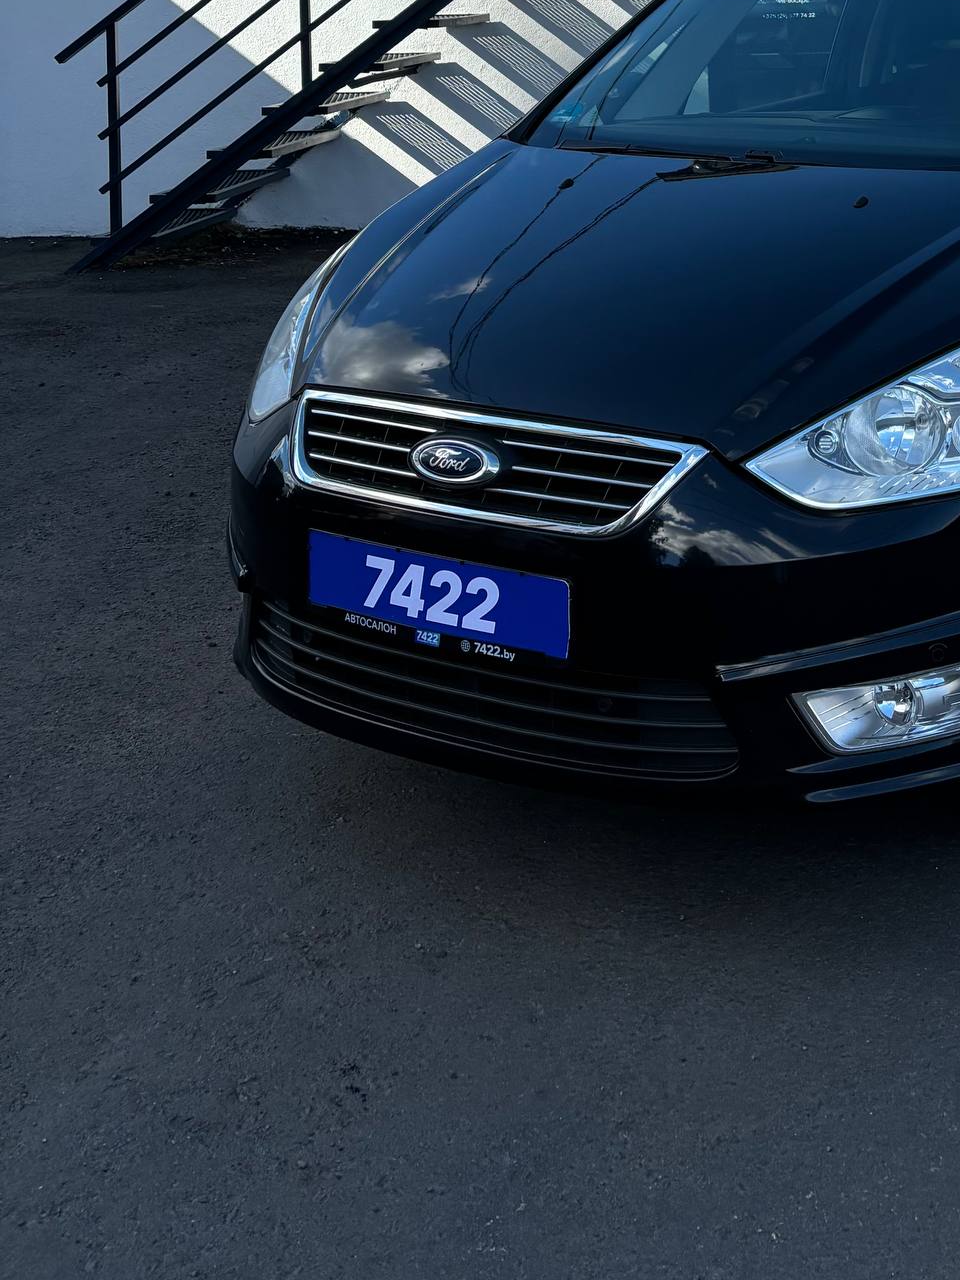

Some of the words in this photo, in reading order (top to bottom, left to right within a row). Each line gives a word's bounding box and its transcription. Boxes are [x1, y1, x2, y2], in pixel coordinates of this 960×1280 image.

[429, 448, 470, 472] Ford
[363, 554, 500, 635] 7422
[344, 612, 397, 635] АВТОСАЛОН
[416, 630, 439, 644] 7422
[474, 642, 515, 661] 7422.by
